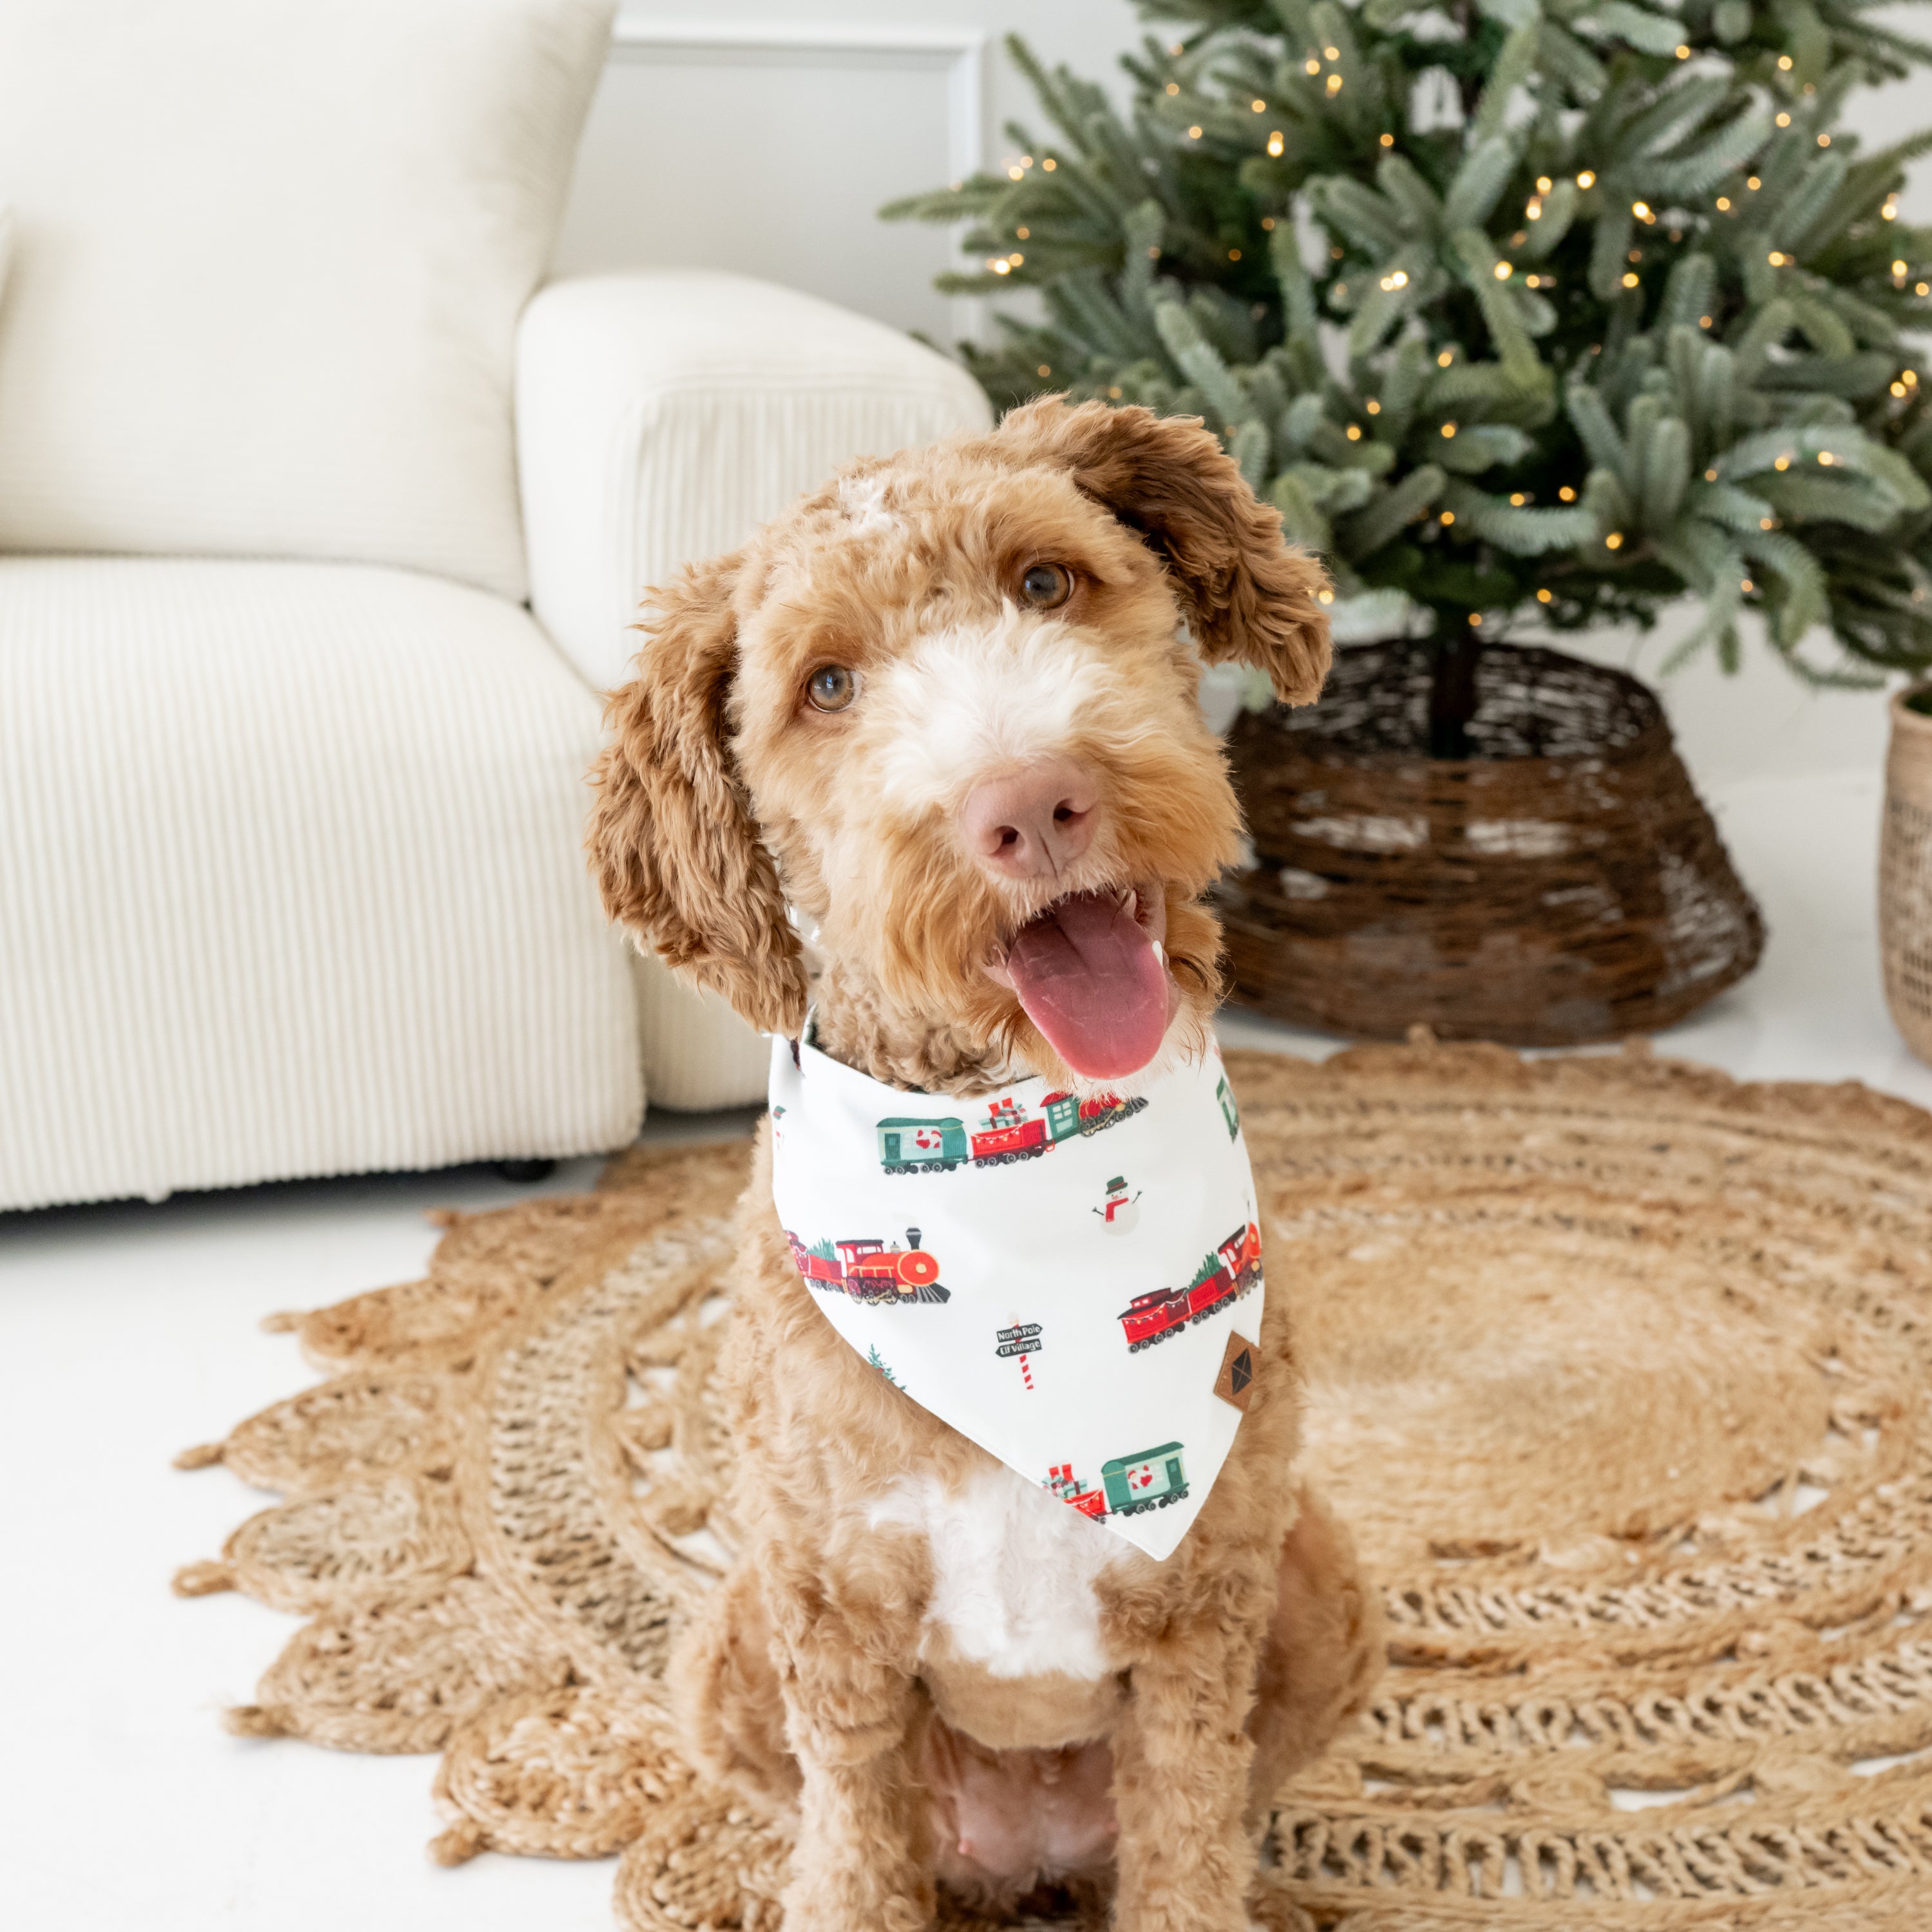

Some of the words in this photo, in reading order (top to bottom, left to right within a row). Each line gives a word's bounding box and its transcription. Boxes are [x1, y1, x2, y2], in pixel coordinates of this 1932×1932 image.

[998, 1329, 1022, 1340] North
[1022, 1325, 1041, 1336] Pole
[999, 1345, 1011, 1355] Elf
[1011, 1341, 1041, 1352] Village
